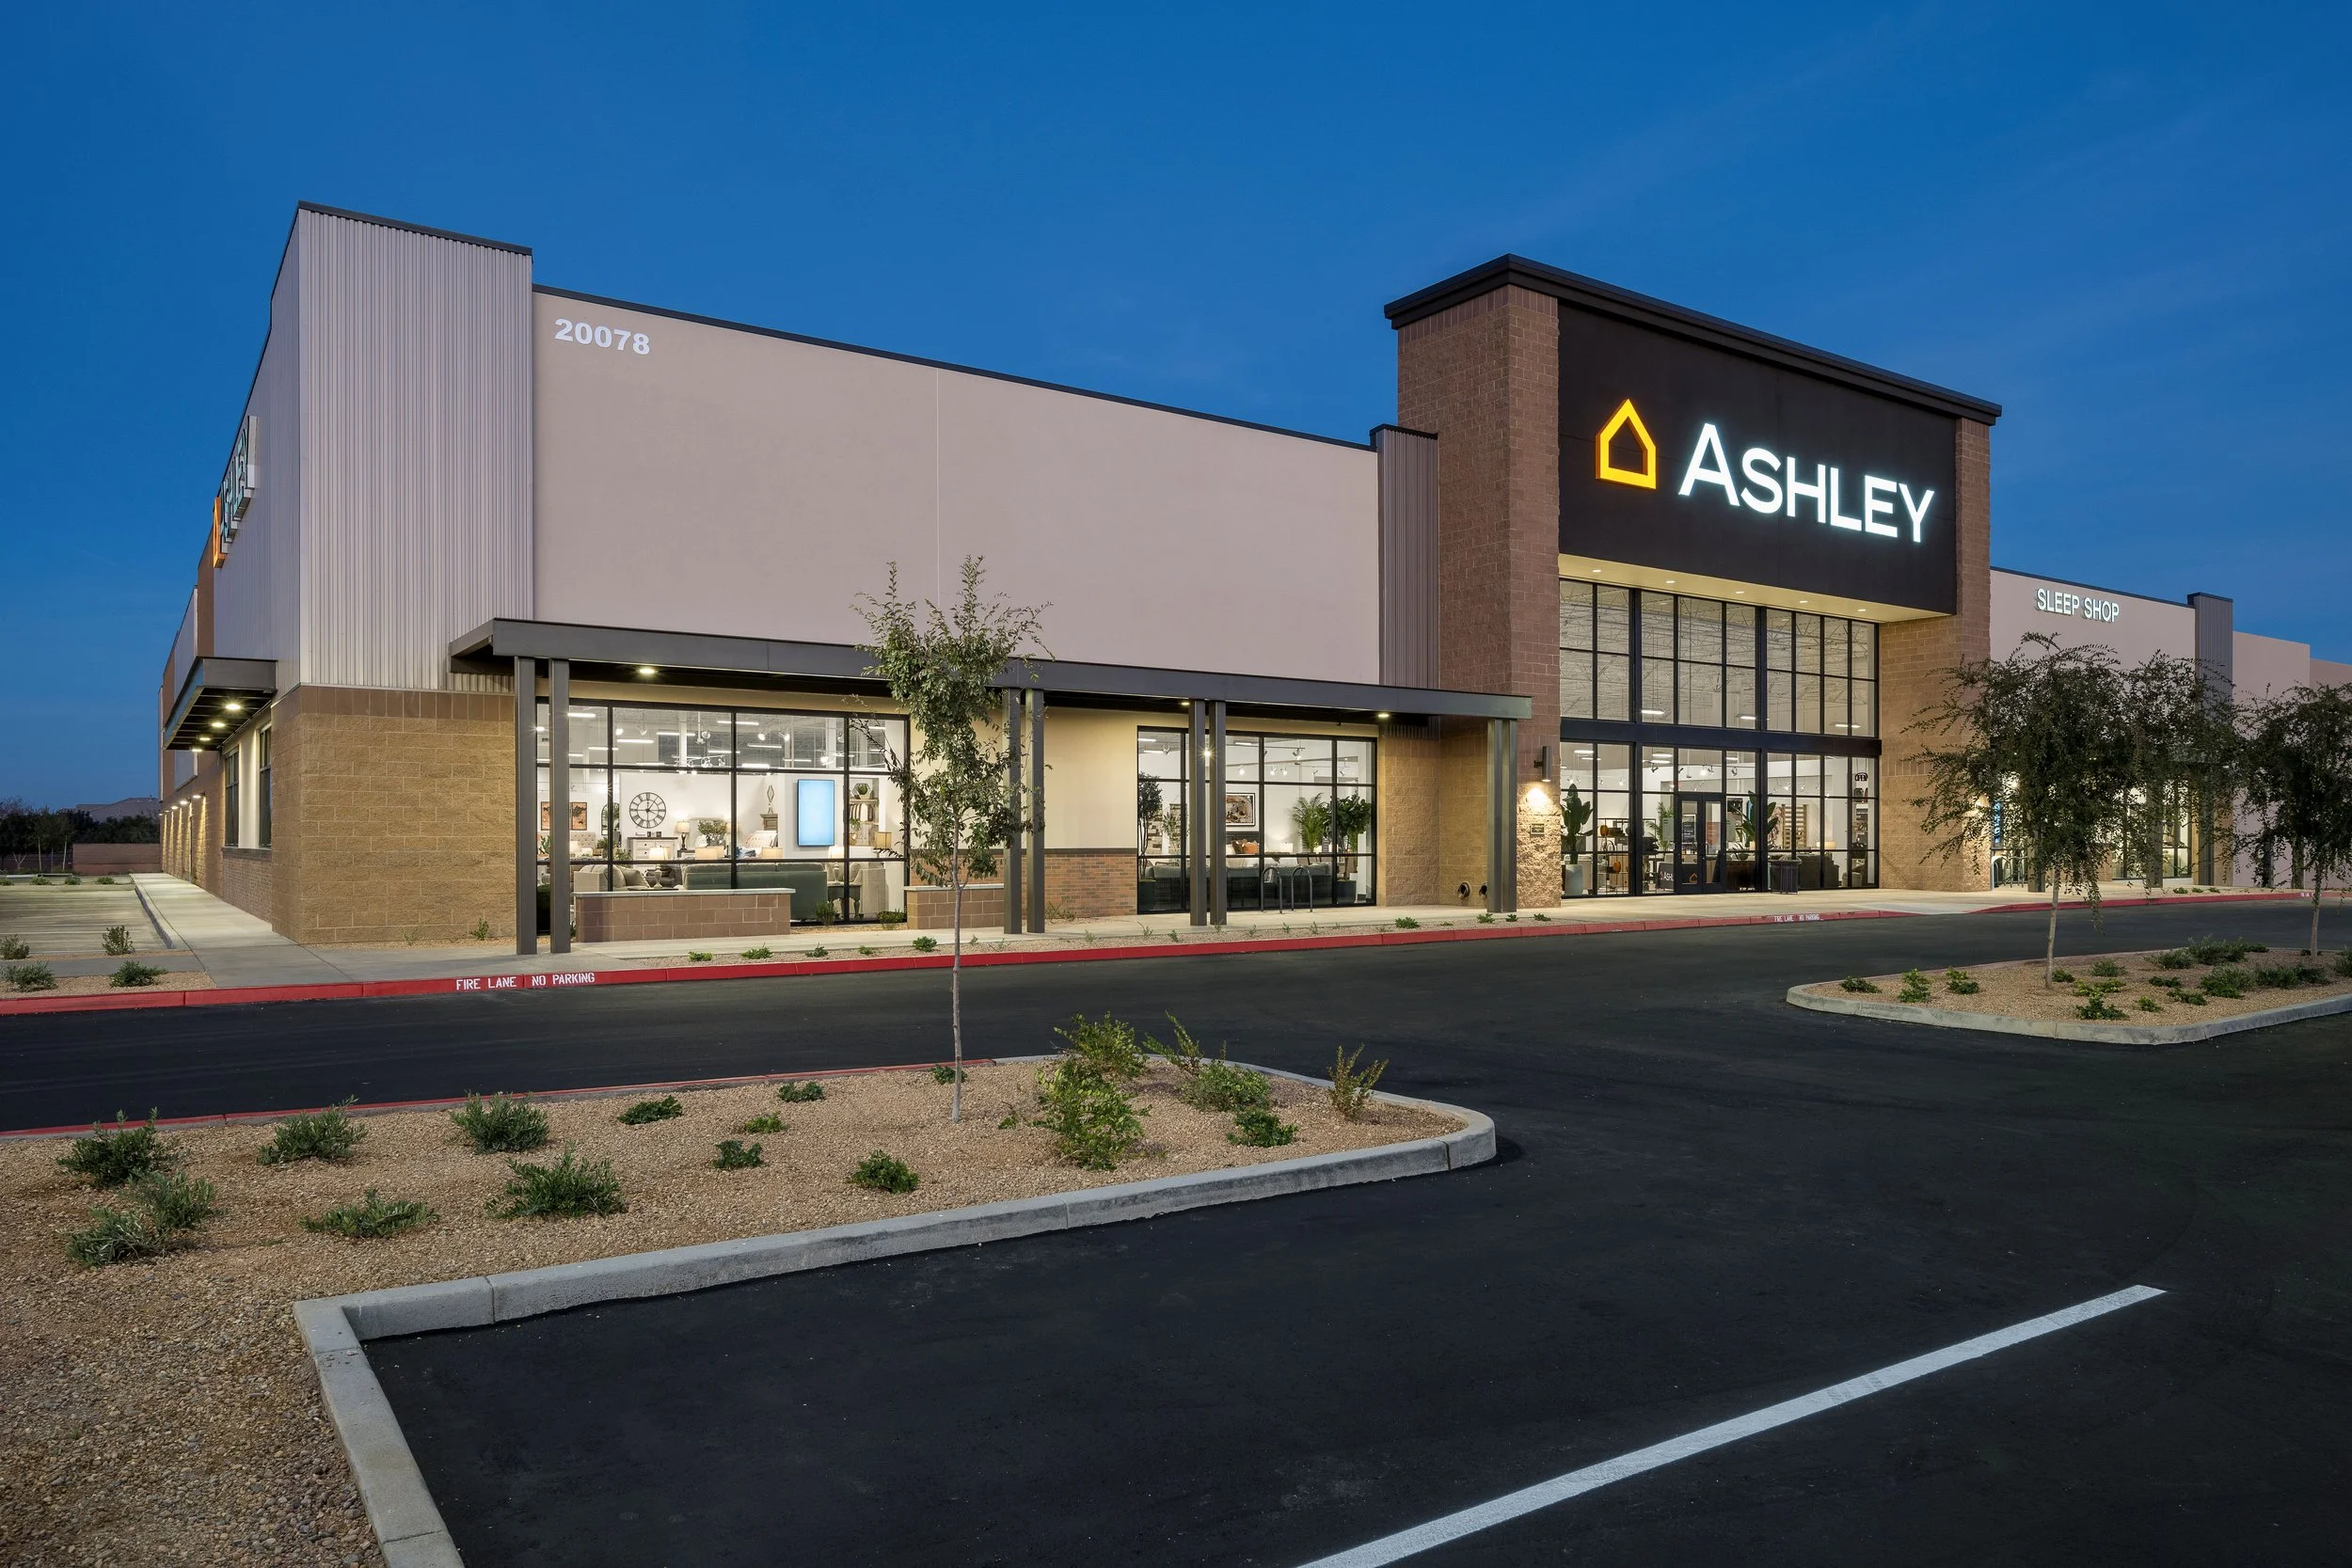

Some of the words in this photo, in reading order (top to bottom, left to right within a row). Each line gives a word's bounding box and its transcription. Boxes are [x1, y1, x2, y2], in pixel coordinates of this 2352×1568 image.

[554, 318, 650, 356] 20078
[1677, 422, 1935, 543] ASHLEY
[2037, 588, 2080, 615] SLEEP
[2084, 597, 2120, 623] SHOP
[455, 978, 481, 990] FIRE
[487, 976, 516, 989] LANE
[532, 974, 546, 987] NO
[552, 972, 596, 985] PARKING
